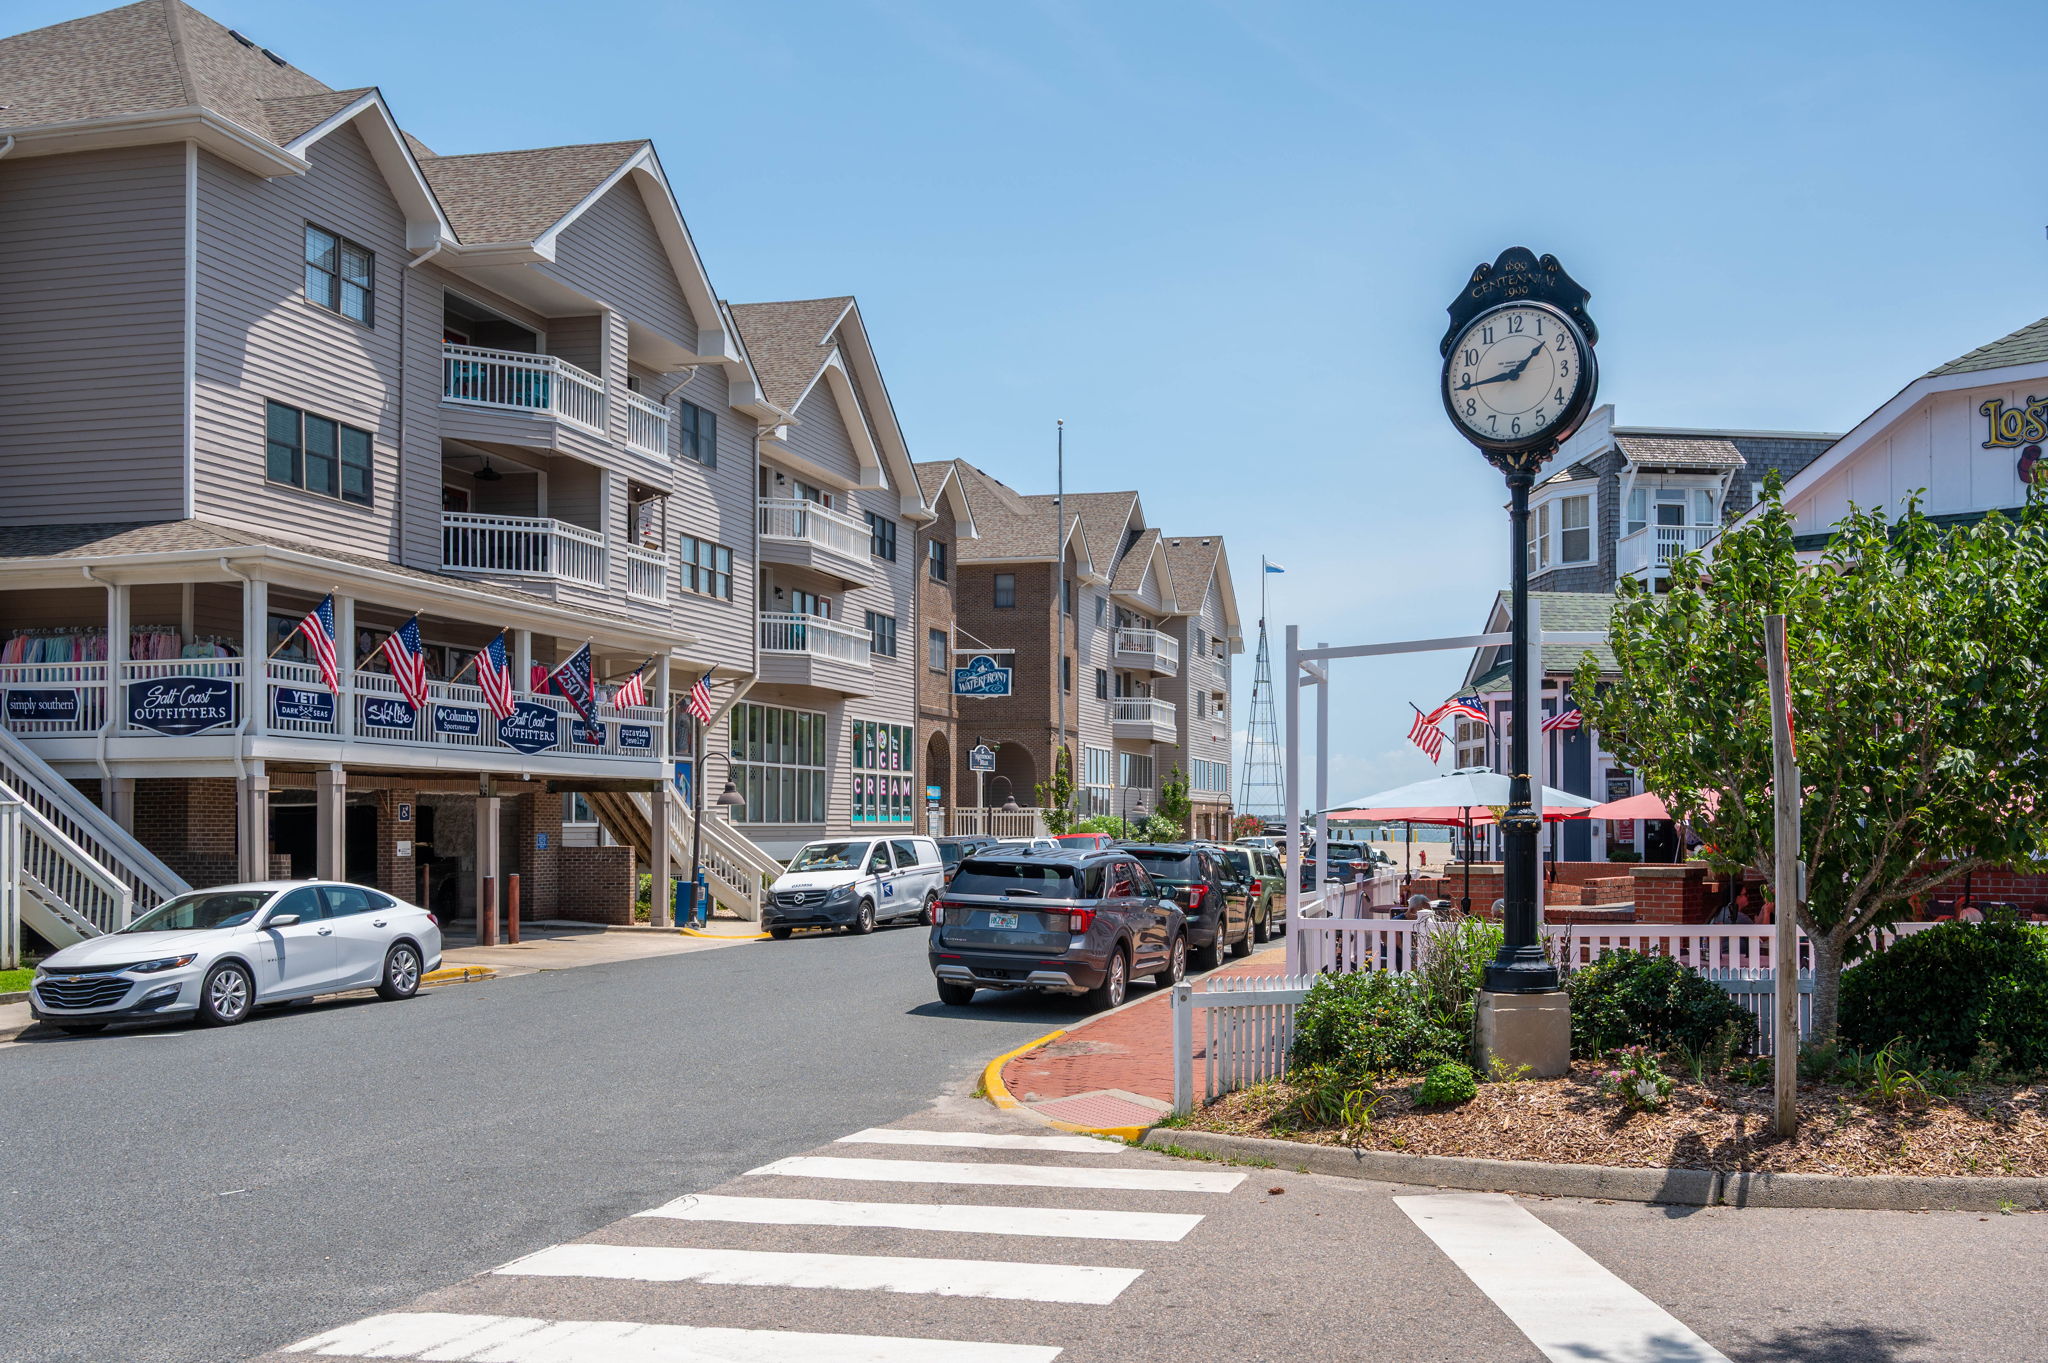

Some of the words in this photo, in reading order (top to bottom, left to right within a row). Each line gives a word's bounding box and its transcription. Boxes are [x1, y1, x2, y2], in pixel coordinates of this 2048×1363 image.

[1472, 273, 1556, 298] CENTENNIAL
[1507, 315, 1523, 334] 12
[1536, 318, 1542, 336] 1
[1481, 327, 1494, 345] 11
[1556, 333, 1566, 351] 2
[1464, 348, 1479, 367] 10
[1560, 360, 1569, 377] 3
[1462, 372, 1471, 390] 9
[1554, 387, 1564, 405] 4
[1466, 398, 1477, 416] 8
[1486, 415, 1498, 433] 7
[1511, 416, 1520, 434] 6
[1535, 408, 1546, 427] 5
[557, 670, 581, 695] 250
[958, 671, 1007, 692] WATERFRONT
[143, 685, 180, 708] Salt
[180, 684, 227, 706] Coast
[292, 690, 319, 705] YETI
[10, 697, 36, 715] simply
[38, 697, 74, 710] southern
[134, 707, 226, 720] OUTFITTERS
[281, 706, 299, 715] DARK
[313, 710, 328, 718] SEAS
[444, 708, 477, 723] Columbia
[507, 708, 529, 728] Salt
[528, 710, 556, 728] Coast
[443, 721, 471, 731] Sportswear
[501, 727, 555, 741] OUTFITTERS
[621, 728, 649, 738] puravida
[625, 737, 646, 745] jewelry
[868, 750, 898, 768] ICE
[854, 777, 910, 796] CREAM
